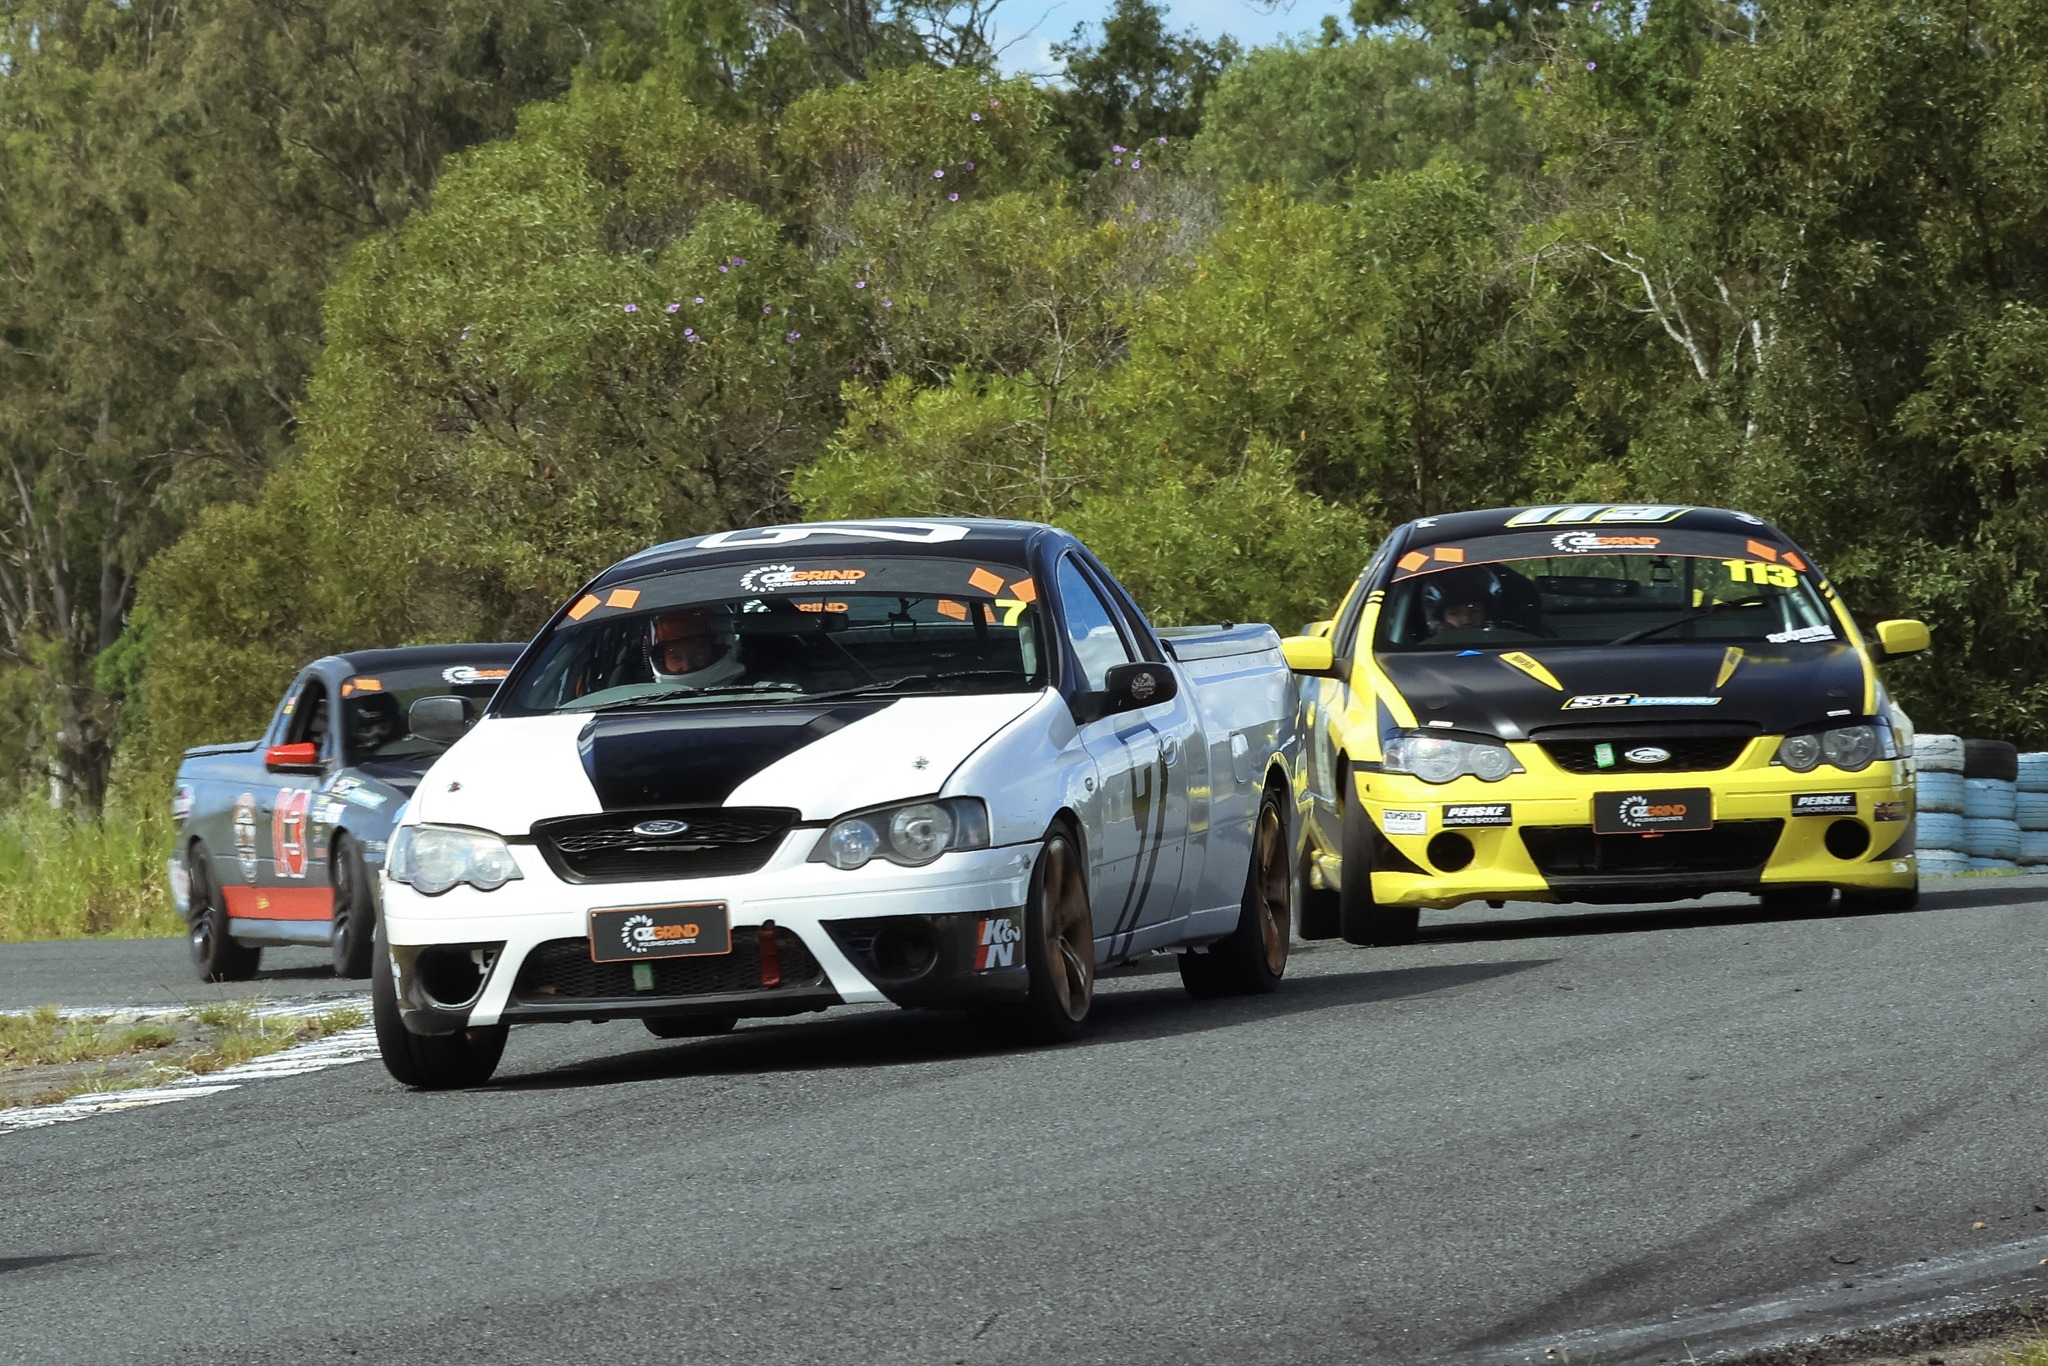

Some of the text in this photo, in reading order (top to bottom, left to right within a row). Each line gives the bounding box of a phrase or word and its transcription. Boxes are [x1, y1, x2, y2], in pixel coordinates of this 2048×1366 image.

[1721, 559, 1799, 588] 113
[994, 599, 1027, 627] 7
[1797, 795, 1852, 806] PENSKE
[1447, 806, 1507, 818] PENSKE
